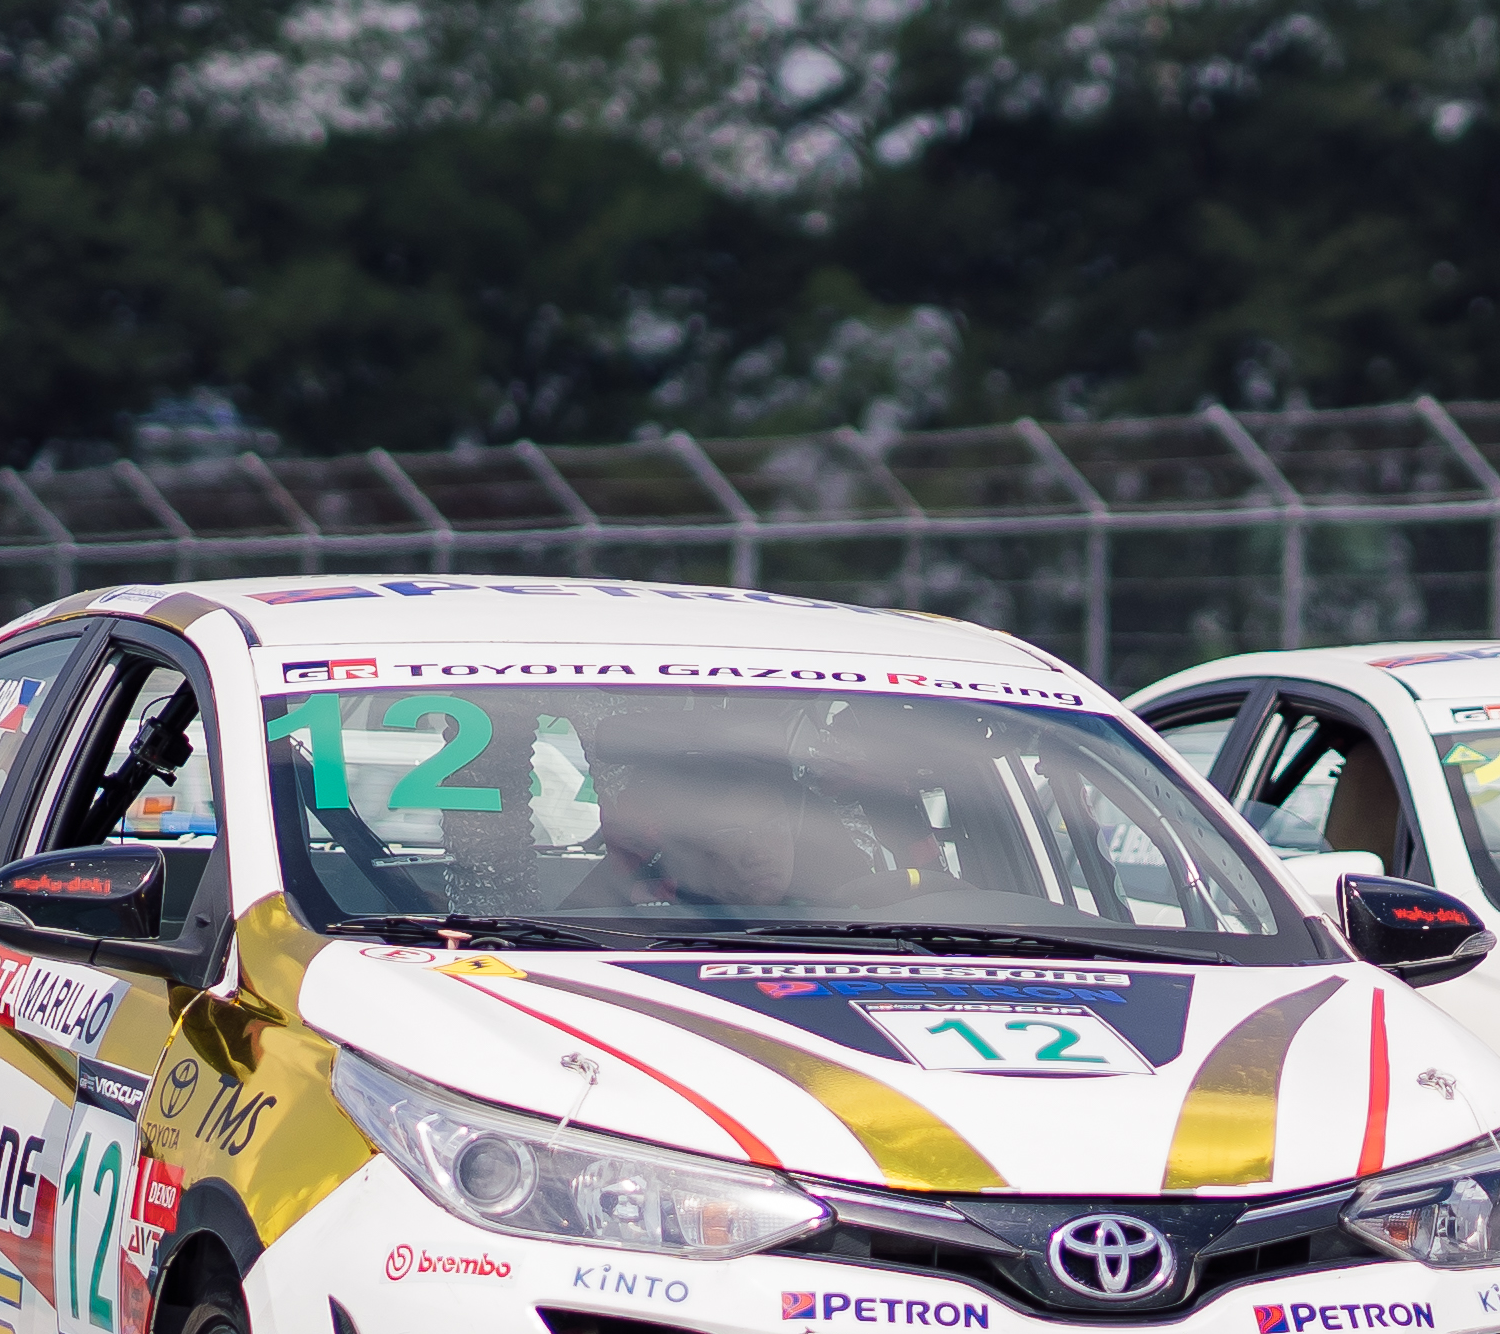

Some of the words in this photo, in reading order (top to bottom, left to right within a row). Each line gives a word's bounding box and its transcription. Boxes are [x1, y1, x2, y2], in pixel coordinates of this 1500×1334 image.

[283, 659, 377, 683] GR
[395, 664, 635, 677] TOYOTA
[658, 664, 867, 683] GAZOO
[887, 672, 1083, 707] Racing
[267, 693, 502, 812] 12
[701, 964, 1130, 987] BRIDGESTONE
[828, 980, 1127, 1003] PETRON
[18, 968, 115, 1045] MARILAO
[925, 1018, 1111, 1064] 12
[195, 1073, 277, 1156] TMS
[146, 1122, 180, 1150] TOYOTA
[149, 1181, 176, 1208] DENSO
[62, 1131, 122, 1334] 12
[417, 1250, 512, 1278] brembo
[823, 1293, 989, 1329] PETRON
[1290, 1302, 1435, 1332] PETRON
